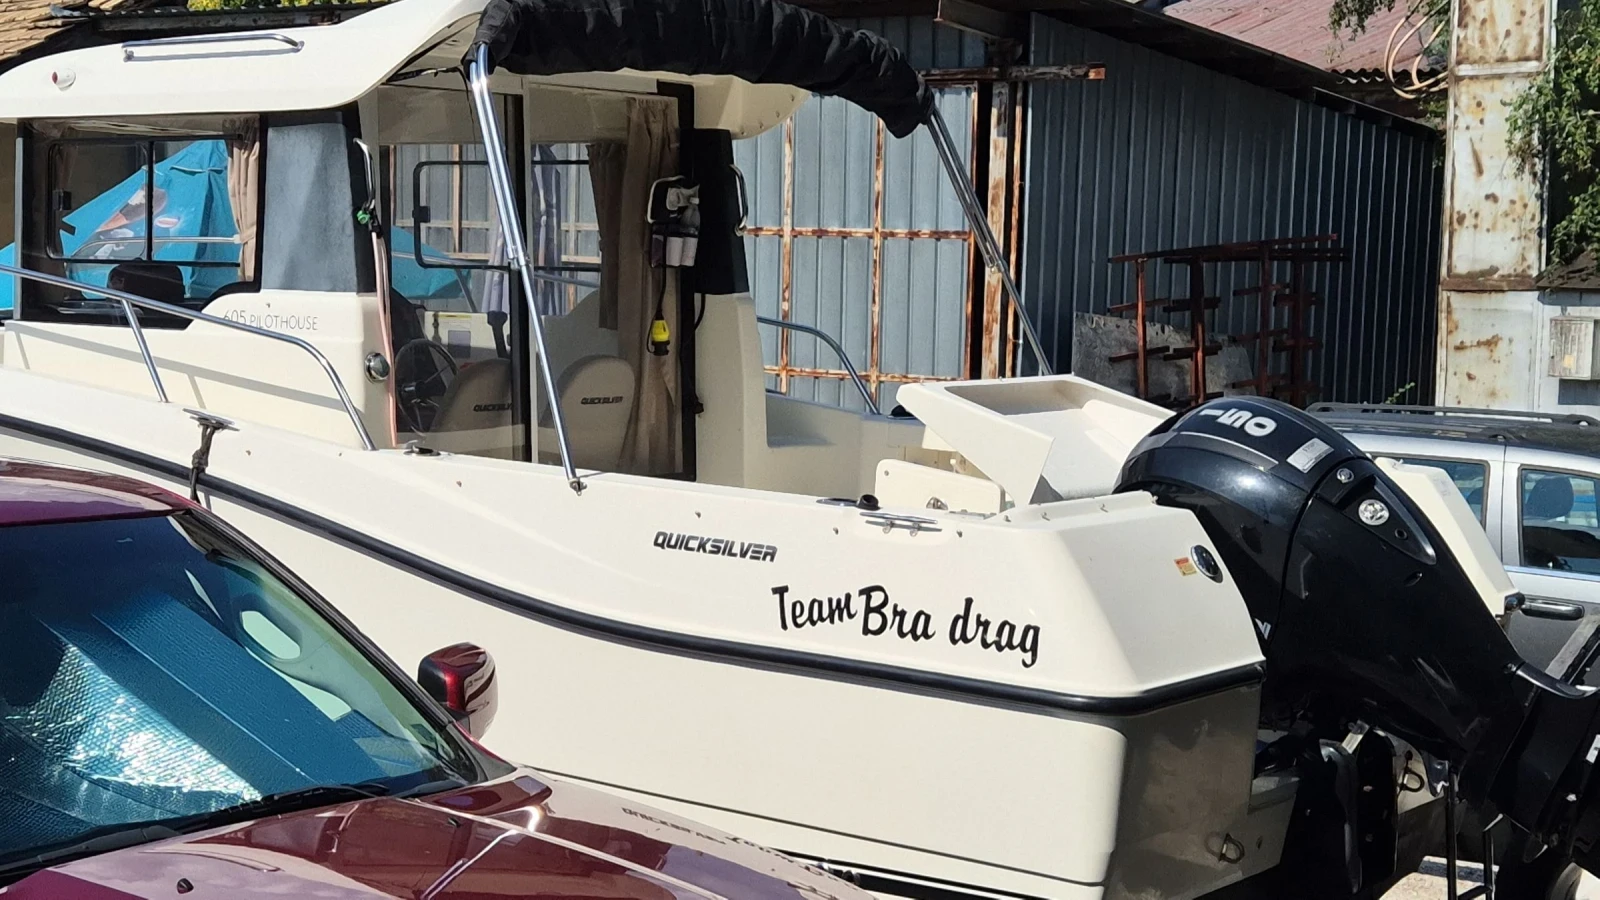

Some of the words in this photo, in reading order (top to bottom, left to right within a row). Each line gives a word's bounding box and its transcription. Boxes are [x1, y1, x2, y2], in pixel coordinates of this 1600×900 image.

[249, 314, 319, 331] PILOTHOUSE
[1198, 408, 1278, 437] 150
[653, 531, 778, 562] QUICKSILVER
[771, 585, 858, 631] Team
[858, 584, 936, 642] Bra
[949, 597, 1041, 668] drag
